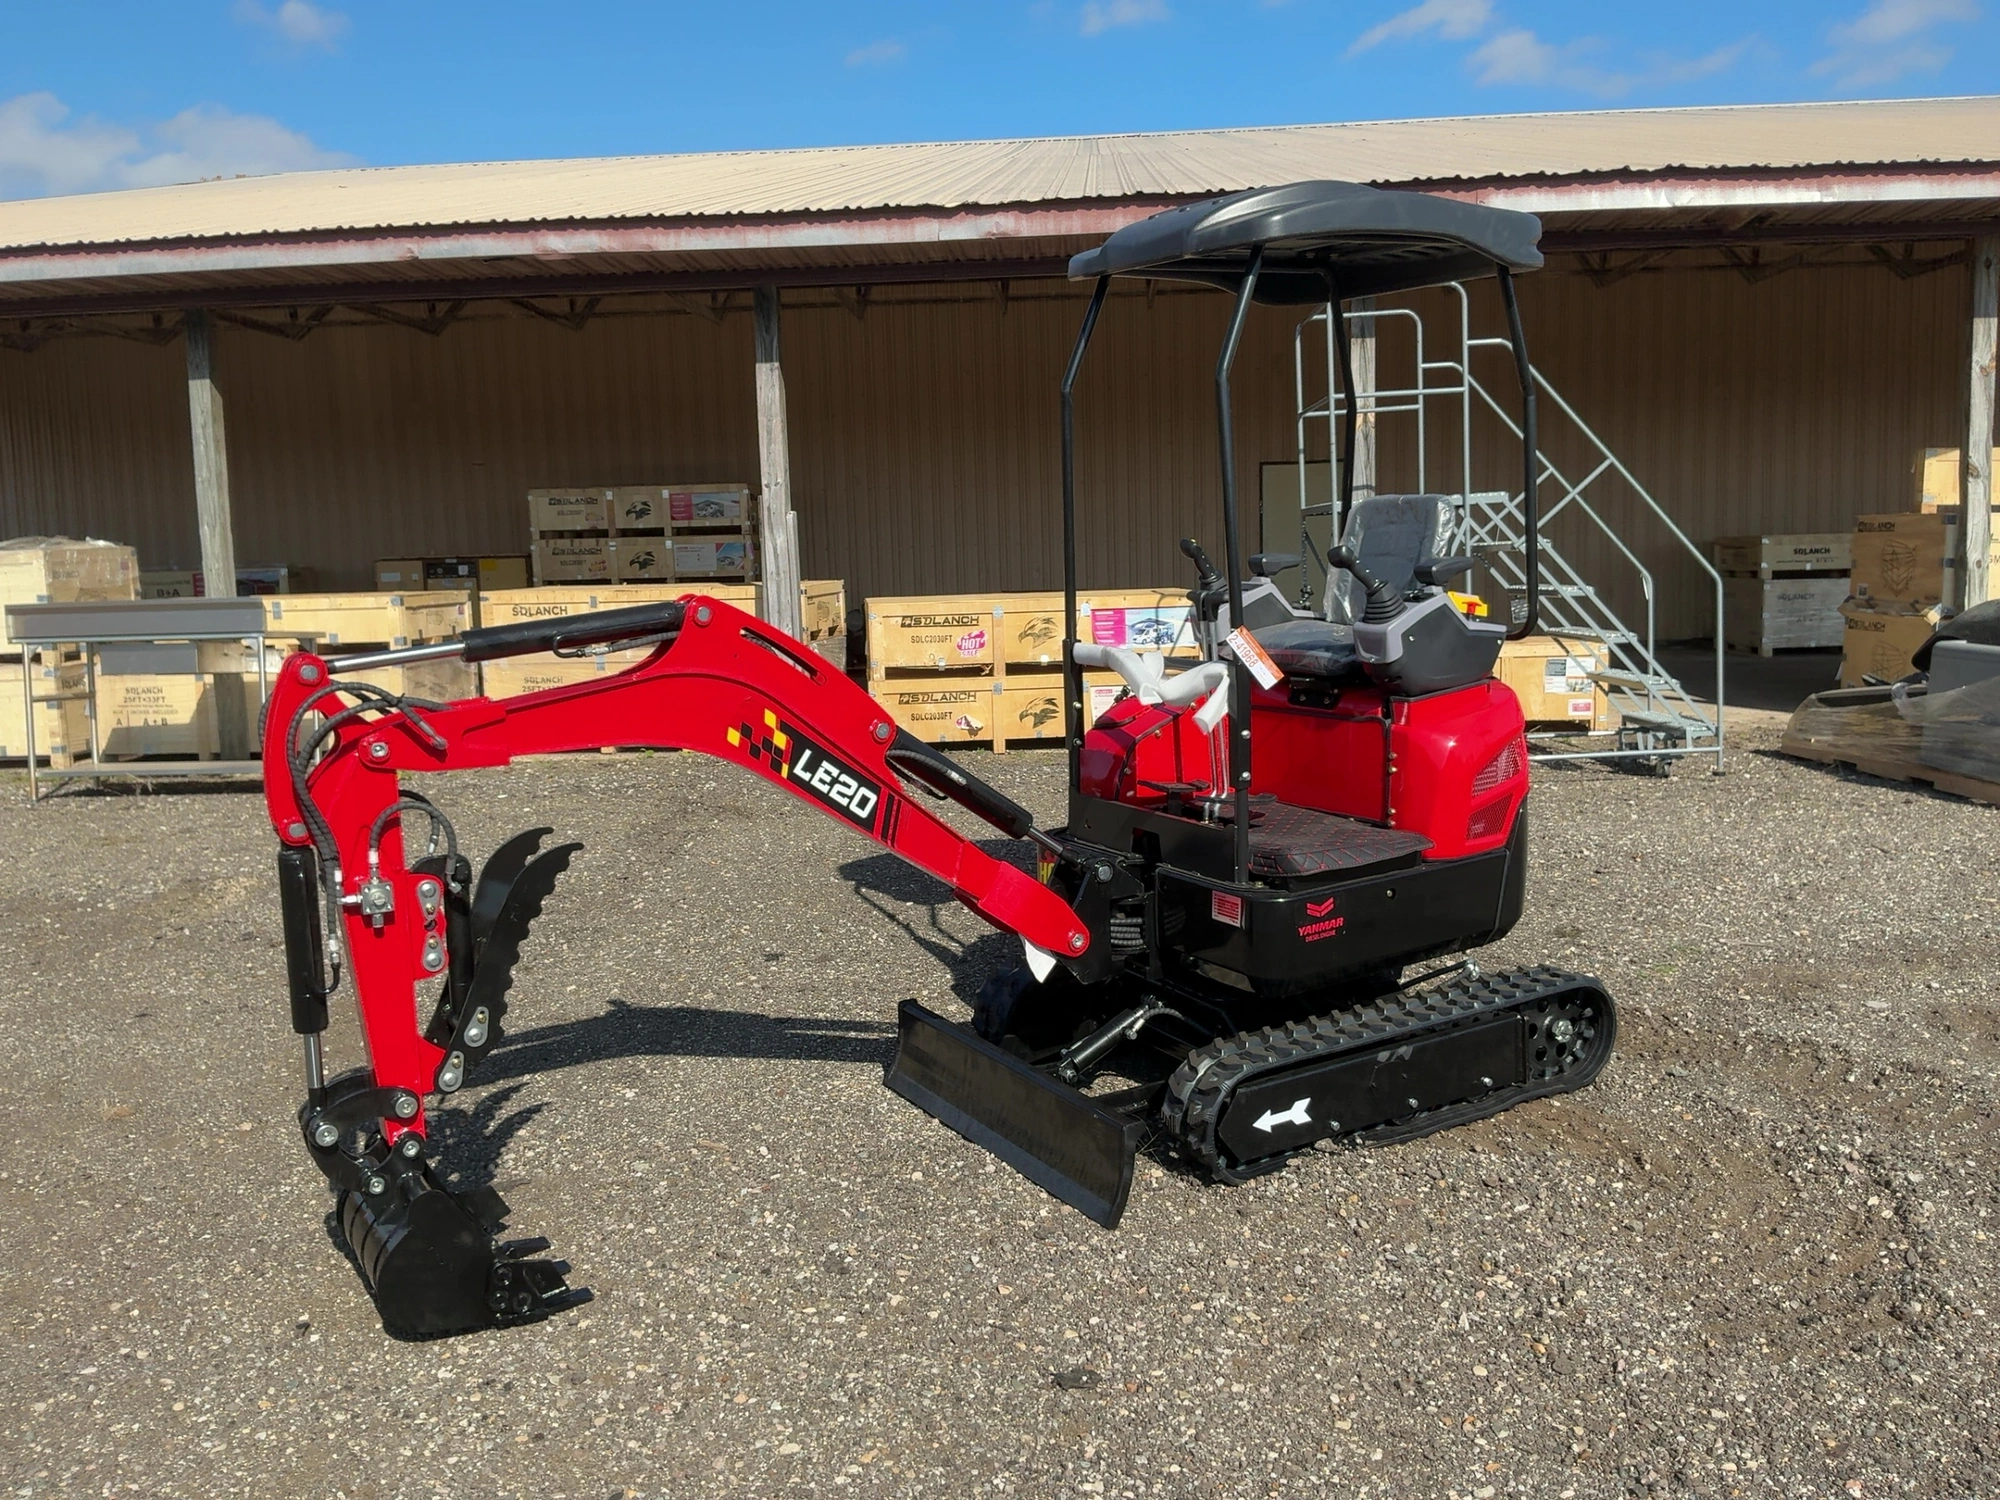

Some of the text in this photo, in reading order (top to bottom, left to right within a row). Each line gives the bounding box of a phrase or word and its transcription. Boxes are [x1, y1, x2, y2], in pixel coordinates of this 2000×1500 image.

[512, 605, 568, 617] SDLANCH
[913, 615, 980, 626] SDLANCH
[911, 635, 953, 644] SDLC2030FT
[961, 638, 981, 650] HOT
[1228, 634, 1259, 668] 2-41968
[911, 692, 977, 703] SDLANCH
[911, 712, 953, 721] SDLC2030FT
[793, 749, 878, 819] LE20
[1298, 917, 1344, 936] YANMAR
